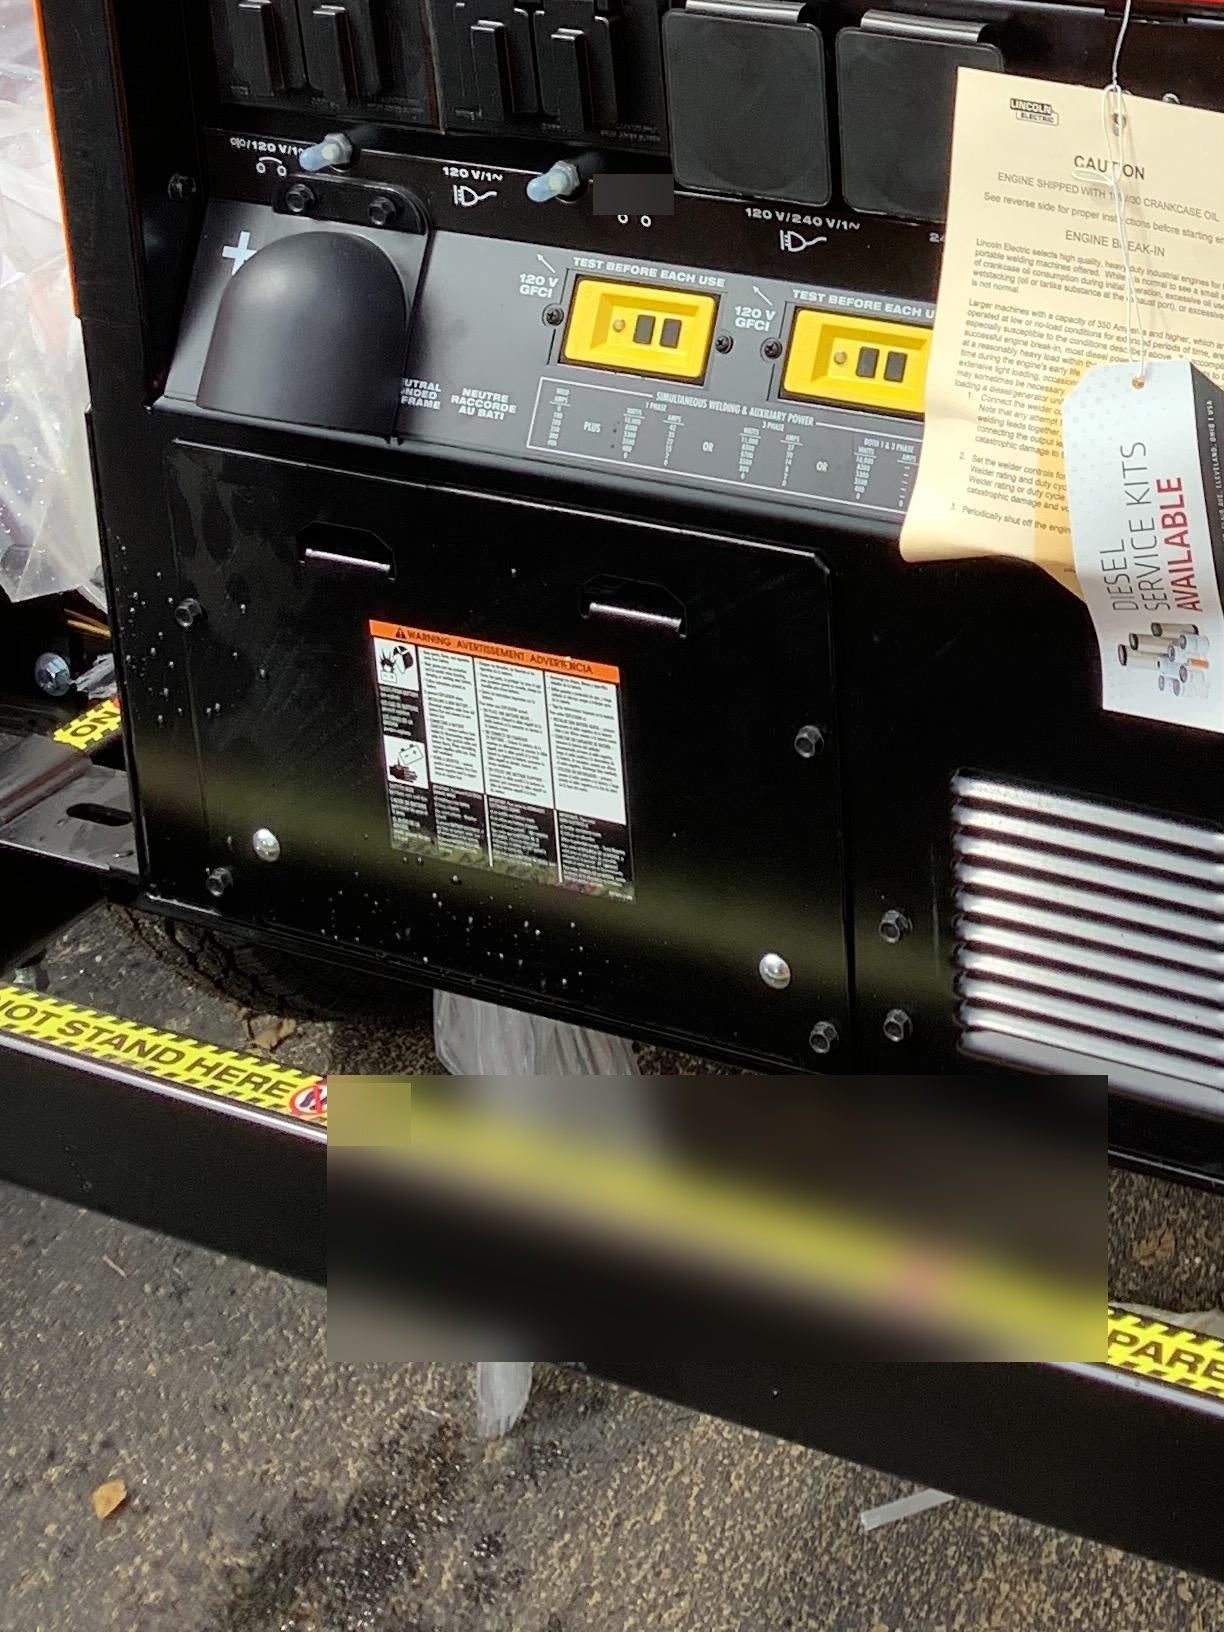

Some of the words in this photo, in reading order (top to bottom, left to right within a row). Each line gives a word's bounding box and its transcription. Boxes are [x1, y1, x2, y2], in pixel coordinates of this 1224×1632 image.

[1011, 99, 1051, 114] LINCOLN
[1020, 112, 1055, 123] ELECTRIC
[442, 166, 470, 179] 120
[1073, 154, 1145, 180] CAUTON
[998, 172, 1035, 187] ENGINE
[1037, 178, 1079, 194] SHIPPED
[1081, 184, 1106, 199] WITH
[1143, 197, 1202, 218] CRANKCASE
[1203, 209, 1220, 222] OIL
[745, 207, 772, 219] 120
[984, 192, 1001, 202] See
[1003, 197, 1036, 209] reverse
[1038, 201, 1055, 213] side
[1057, 204, 1070, 215] for
[1071, 209, 1100, 223] proper
[1153, 220, 1180, 235] before
[1182, 226, 1214, 244] starting
[1065, 229, 1109, 247] ENGINE
[1112, 237, 1165, 257] BEAK-IN
[573, 257, 603, 271] TEST
[607, 261, 657, 278] BEFORE
[660, 269, 696, 283] EACH
[699, 274, 725, 288] USE
[520, 274, 546, 286] 120
[547, 277, 558, 288] V
[519, 284, 553, 299] GFCI
[793, 288, 825, 304] TEST
[829, 293, 882, 311] BEFORE
[885, 301, 923, 317] EACH
[735, 305, 761, 318] 120
[764, 308, 776, 321] V
[734, 317, 770, 332] GFCI
[404, 379, 441, 392] UTRAL
[401, 397, 441, 410] FRAME
[462, 388, 510, 403] NEUTRE
[451, 395, 517, 414] RACCORDE
[656, 391, 707, 409] SIMULTANEOUS
[709, 399, 740, 415] WELDING
[750, 406, 786, 423] AUXILIARY
[787, 413, 814, 426] POWER
[459, 407, 476, 416] AU
[478, 409, 505, 421] BATI
[583, 421, 601, 433] PLUS
[702, 441, 714, 452] OR
[816, 461, 829, 472] OR
[1120, 441, 1155, 507] KITS
[1156, 477, 1202, 613] AVAILABLE
[1130, 517, 1170, 612] SERVICE
[1100, 539, 1139, 611] DIESEL
[407, 630, 451, 647] WARNING
[457, 639, 525, 662] AVERTISSEMENT
[57, 1019, 186, 1066] STAND
[184, 1056, 300, 1100] HERE
